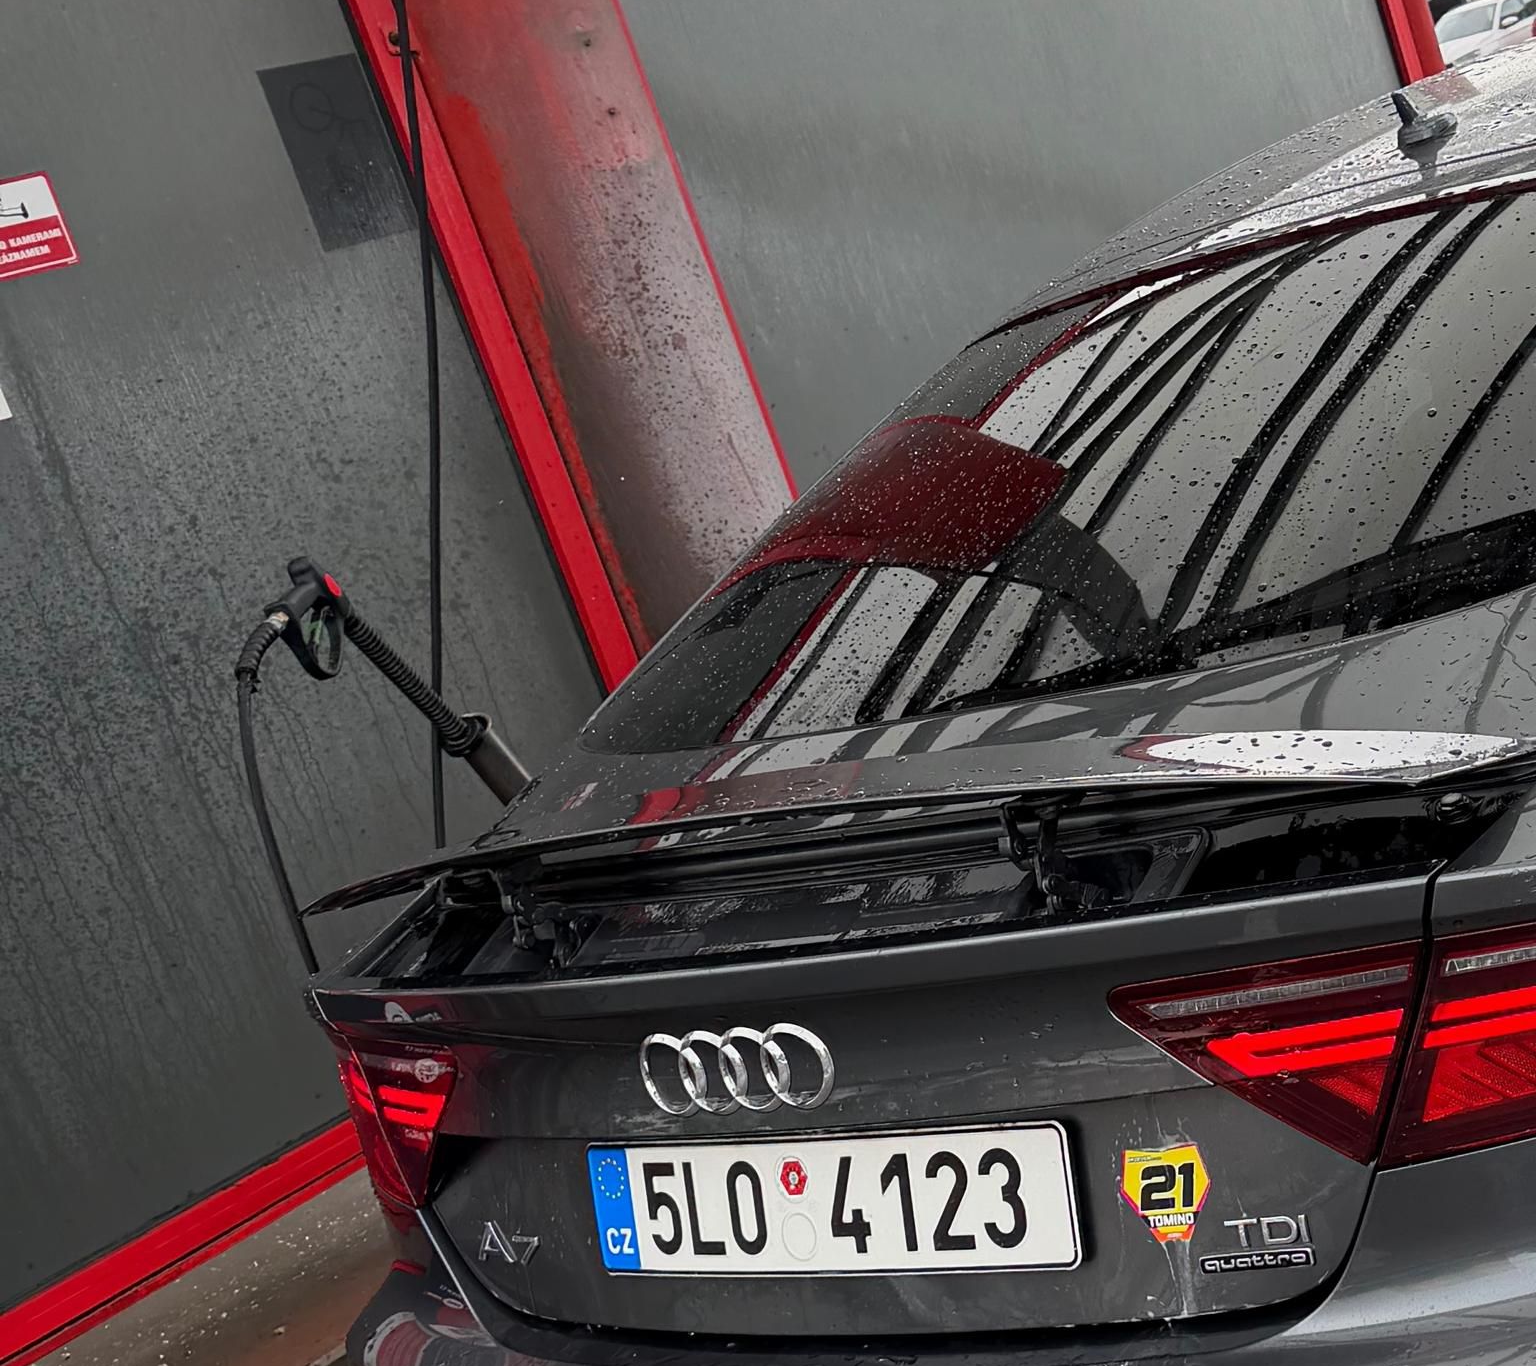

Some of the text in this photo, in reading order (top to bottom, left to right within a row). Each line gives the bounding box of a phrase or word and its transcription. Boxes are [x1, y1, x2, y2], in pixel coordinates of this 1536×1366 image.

[8, 228, 63, 248] KAMERAMI
[606, 1227, 635, 1255] CZ
[831, 1147, 1028, 1255] 4123
[1141, 1162, 1195, 1212] 21
[1148, 1212, 1194, 1228] TOMINO
[1223, 1214, 1310, 1250] TDI
[478, 1219, 540, 1265] A7
[1204, 1253, 1307, 1273] quattro
